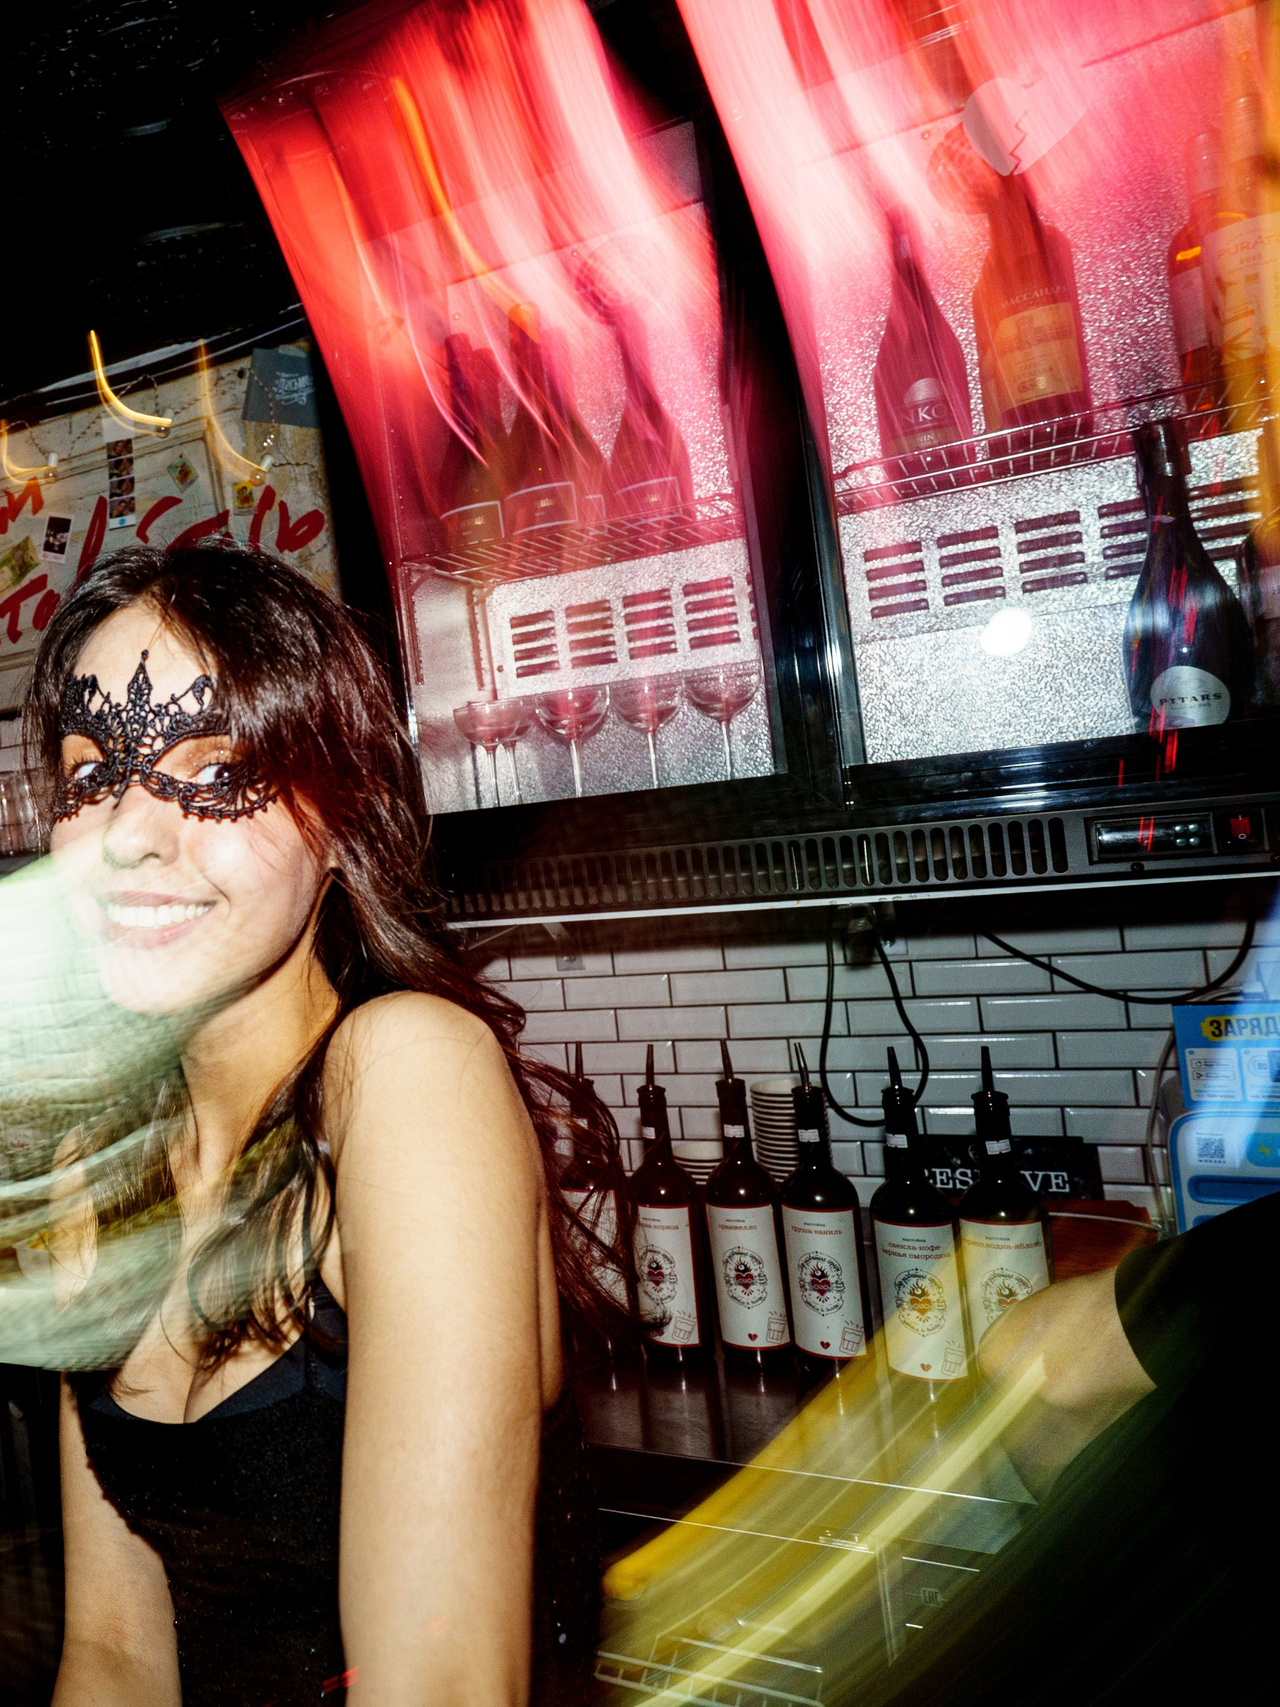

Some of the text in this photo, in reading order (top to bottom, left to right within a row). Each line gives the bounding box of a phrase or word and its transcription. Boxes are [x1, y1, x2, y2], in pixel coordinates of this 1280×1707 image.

[1159, 692, 1222, 706] PITARS
[1209, 1015, 1280, 1037] ЗАРЯД
[924, 1167, 1070, 1193] ESVE
